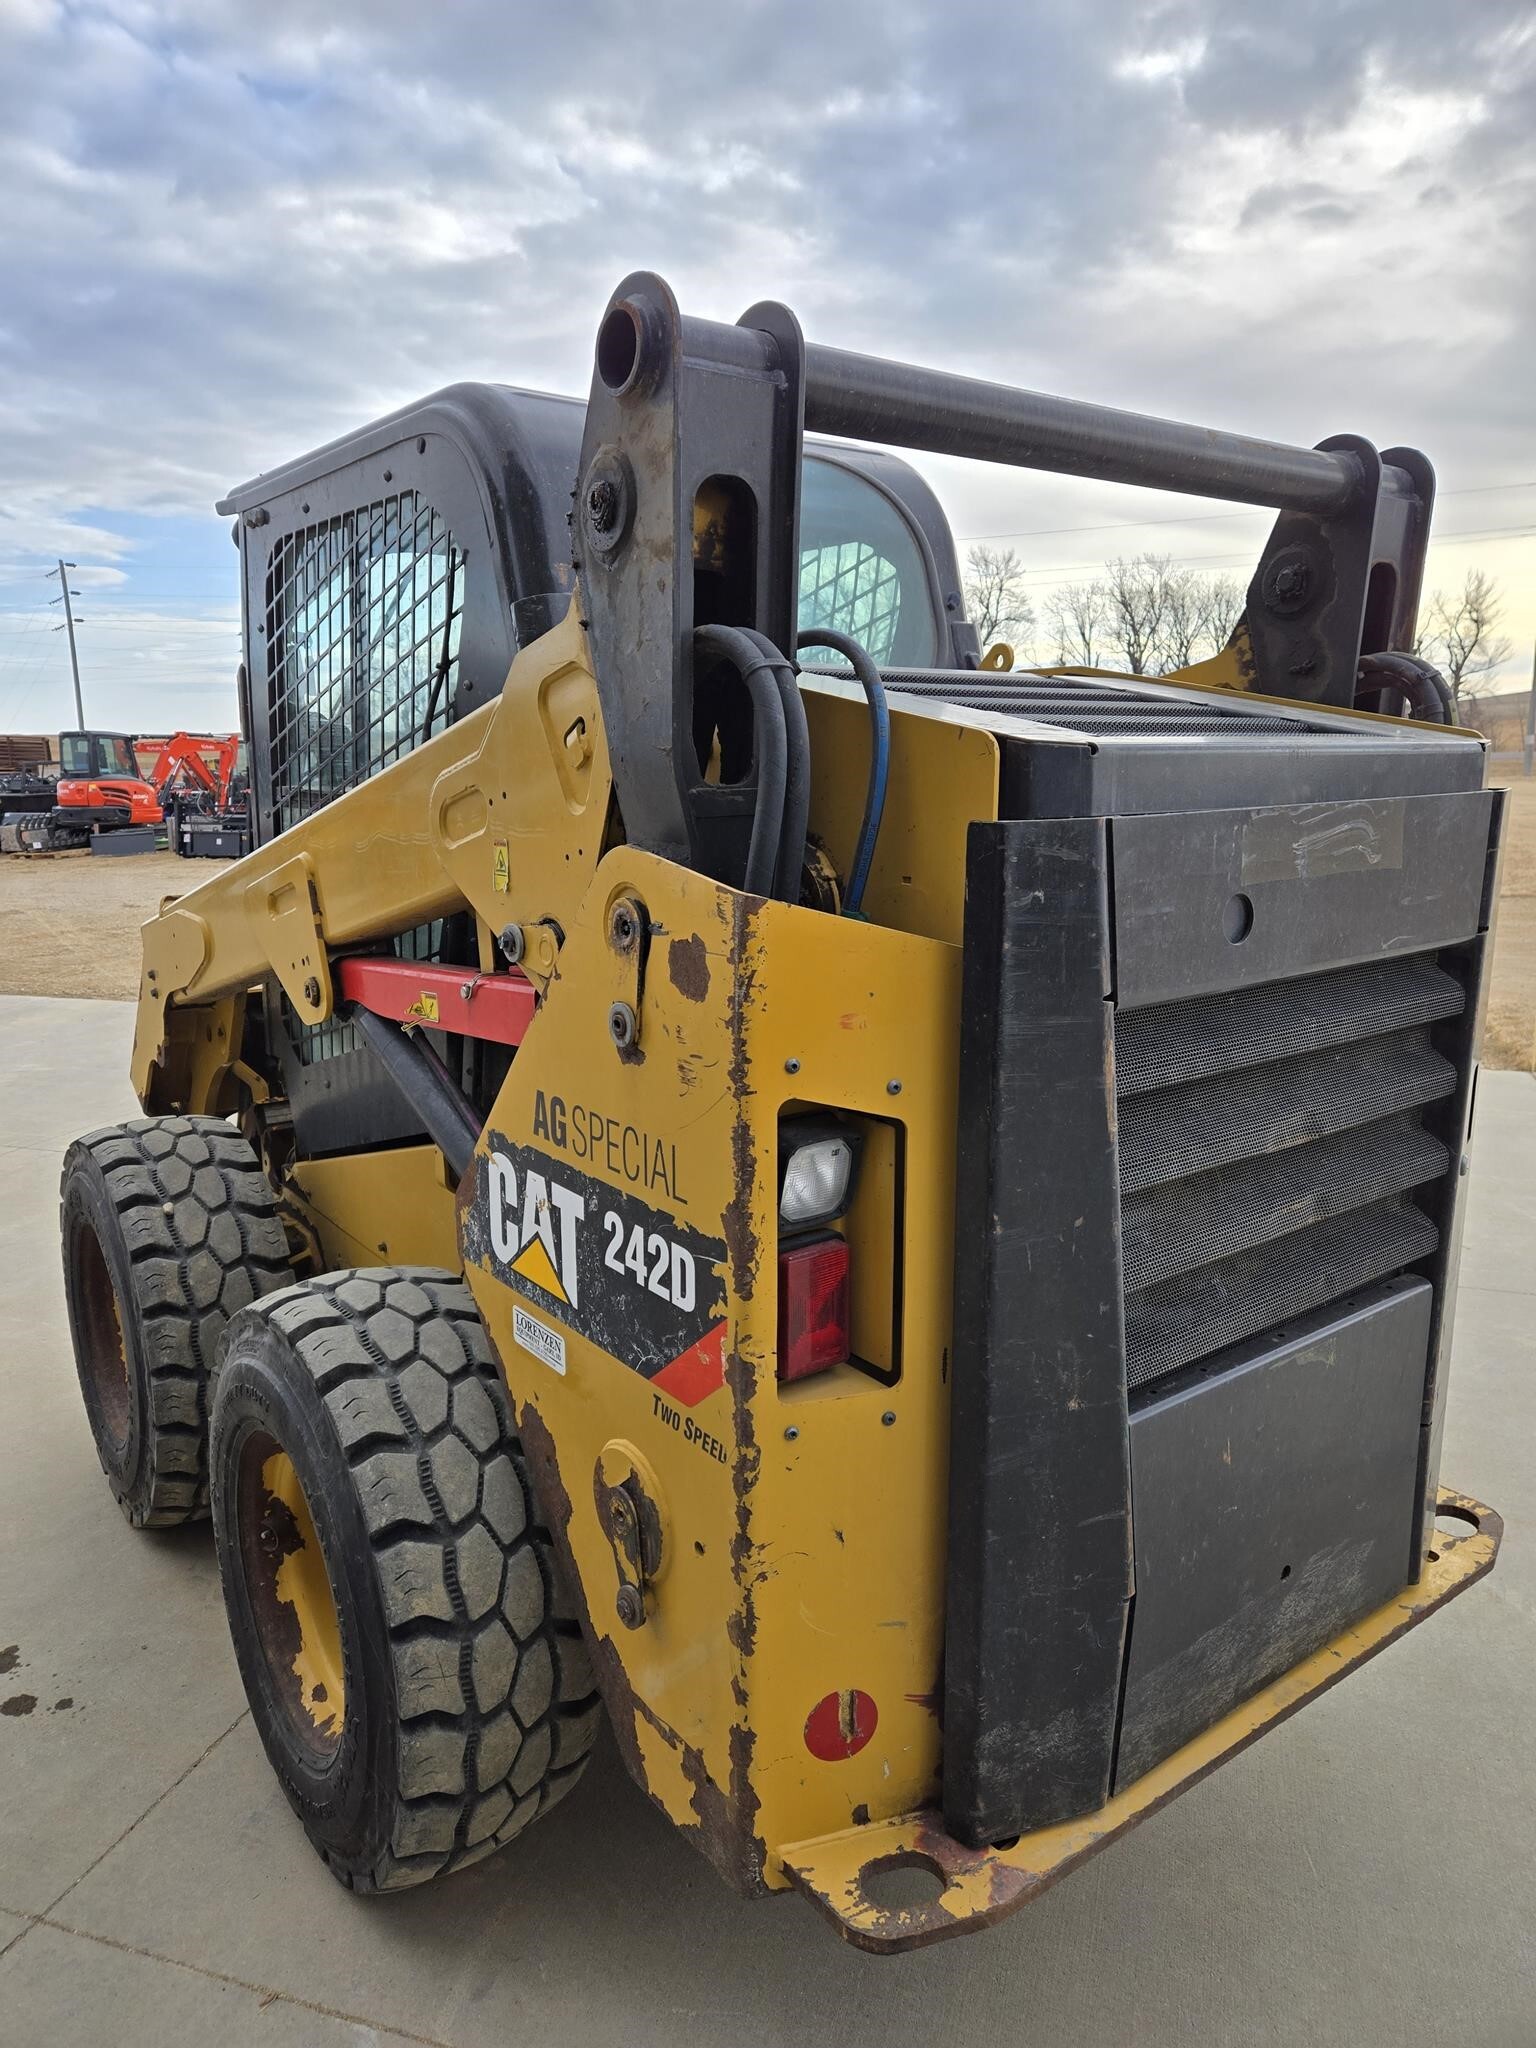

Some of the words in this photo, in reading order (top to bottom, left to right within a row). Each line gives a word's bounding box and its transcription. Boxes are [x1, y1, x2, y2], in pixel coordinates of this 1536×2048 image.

[572, 1104, 688, 1205] SPECIAL
[488, 1151, 585, 1310] CAT
[604, 1210, 696, 1313] 242D
[516, 1313, 561, 1354] LORENZEN
[653, 1393, 680, 1431] TWO
